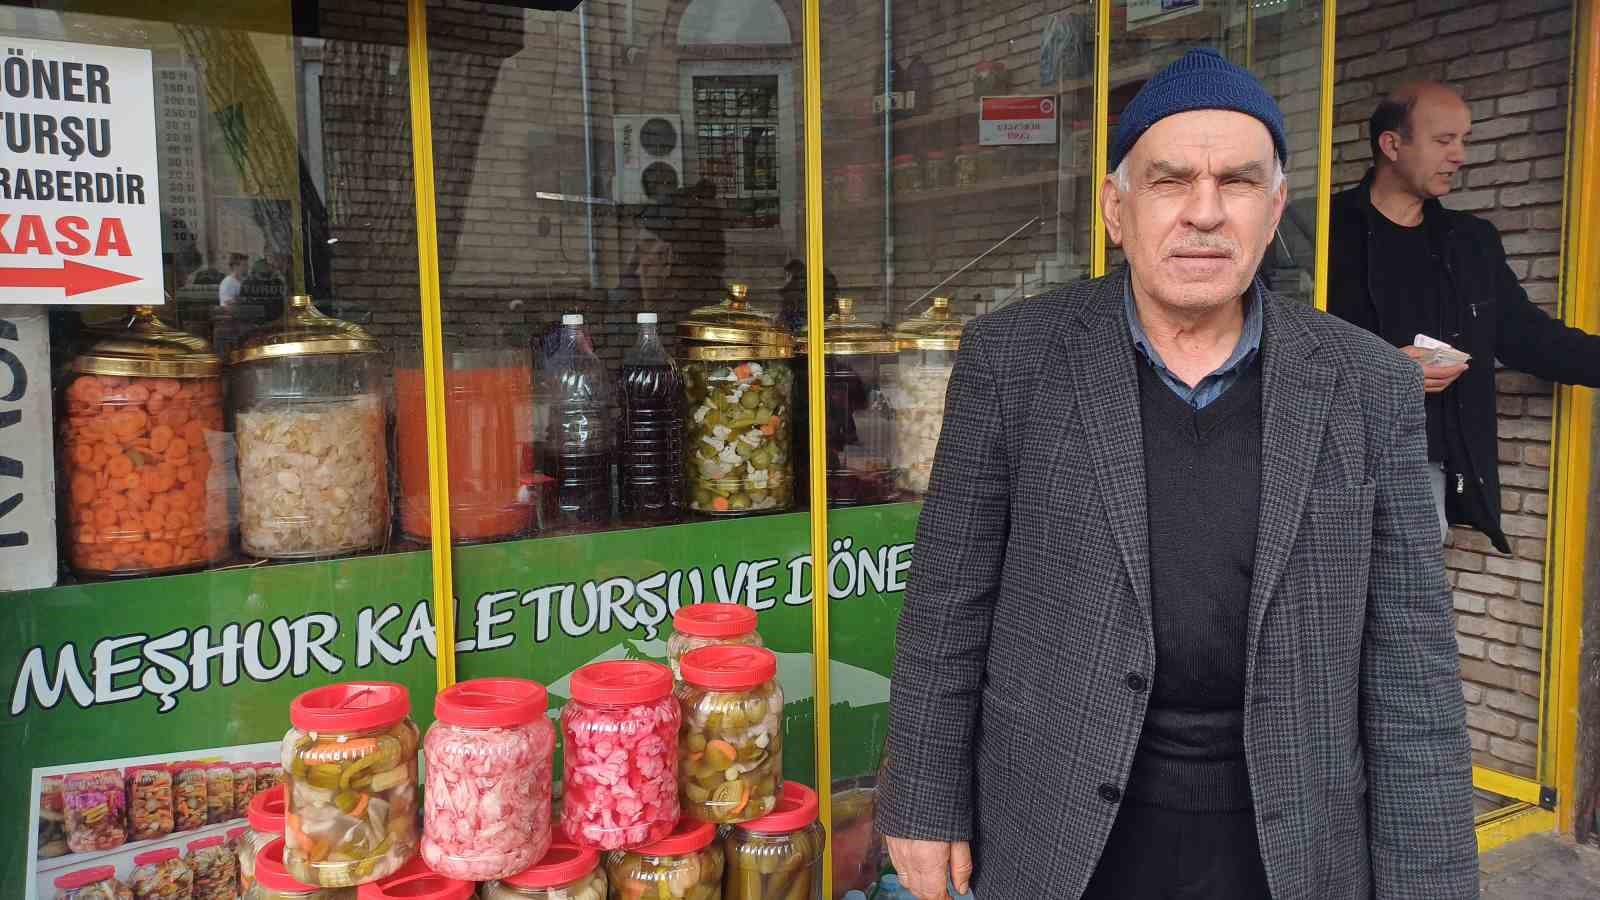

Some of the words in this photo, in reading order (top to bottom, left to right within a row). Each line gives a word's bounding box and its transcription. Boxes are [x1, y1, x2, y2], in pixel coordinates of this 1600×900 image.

[0, 48, 112, 104] ÖNER
[0, 111, 112, 162] URŞU
[11, 612, 344, 715] MEŞHUR
[521, 566, 703, 641] TURŞU
[711, 556, 780, 611] VE
